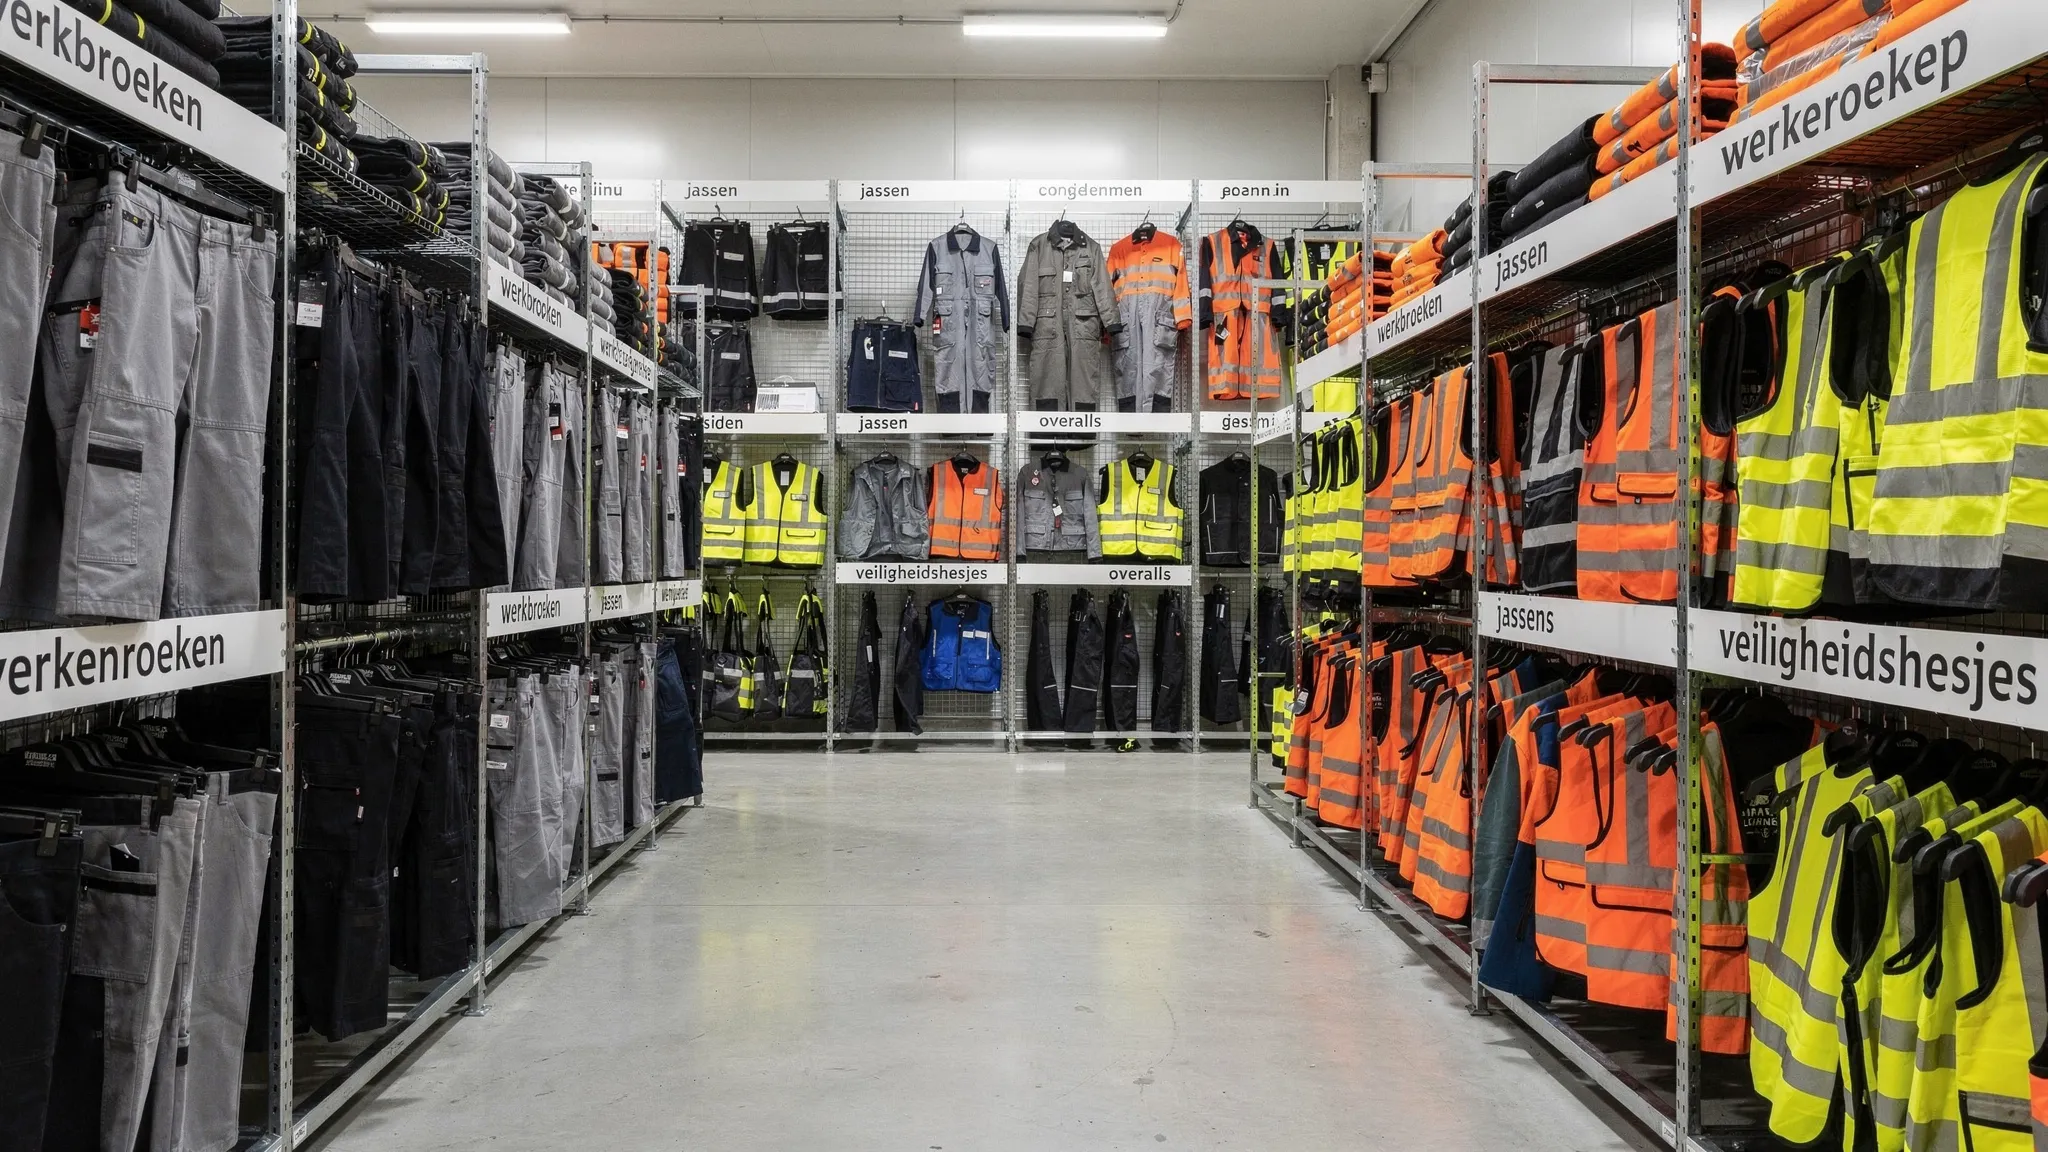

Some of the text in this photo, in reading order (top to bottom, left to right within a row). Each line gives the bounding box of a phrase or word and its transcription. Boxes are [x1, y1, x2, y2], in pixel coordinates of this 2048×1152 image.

[0, 0, 202, 131] erkbroeken
[1721, 29, 1968, 175] werkeroekep
[684, 182, 737, 199] jassen
[860, 183, 909, 200] jassen
[1494, 240, 1547, 292] jassen
[1377, 293, 1442, 344] werkbroeken
[858, 415, 908, 432] jassen
[1040, 413, 1101, 428] overalls
[856, 565, 988, 583] veiligheidshesjes
[1109, 565, 1171, 581] overalls
[1496, 597, 1554, 633] jassens
[0, 624, 224, 696] erkenroeken
[1719, 619, 2037, 713] veiligheidshesjes
